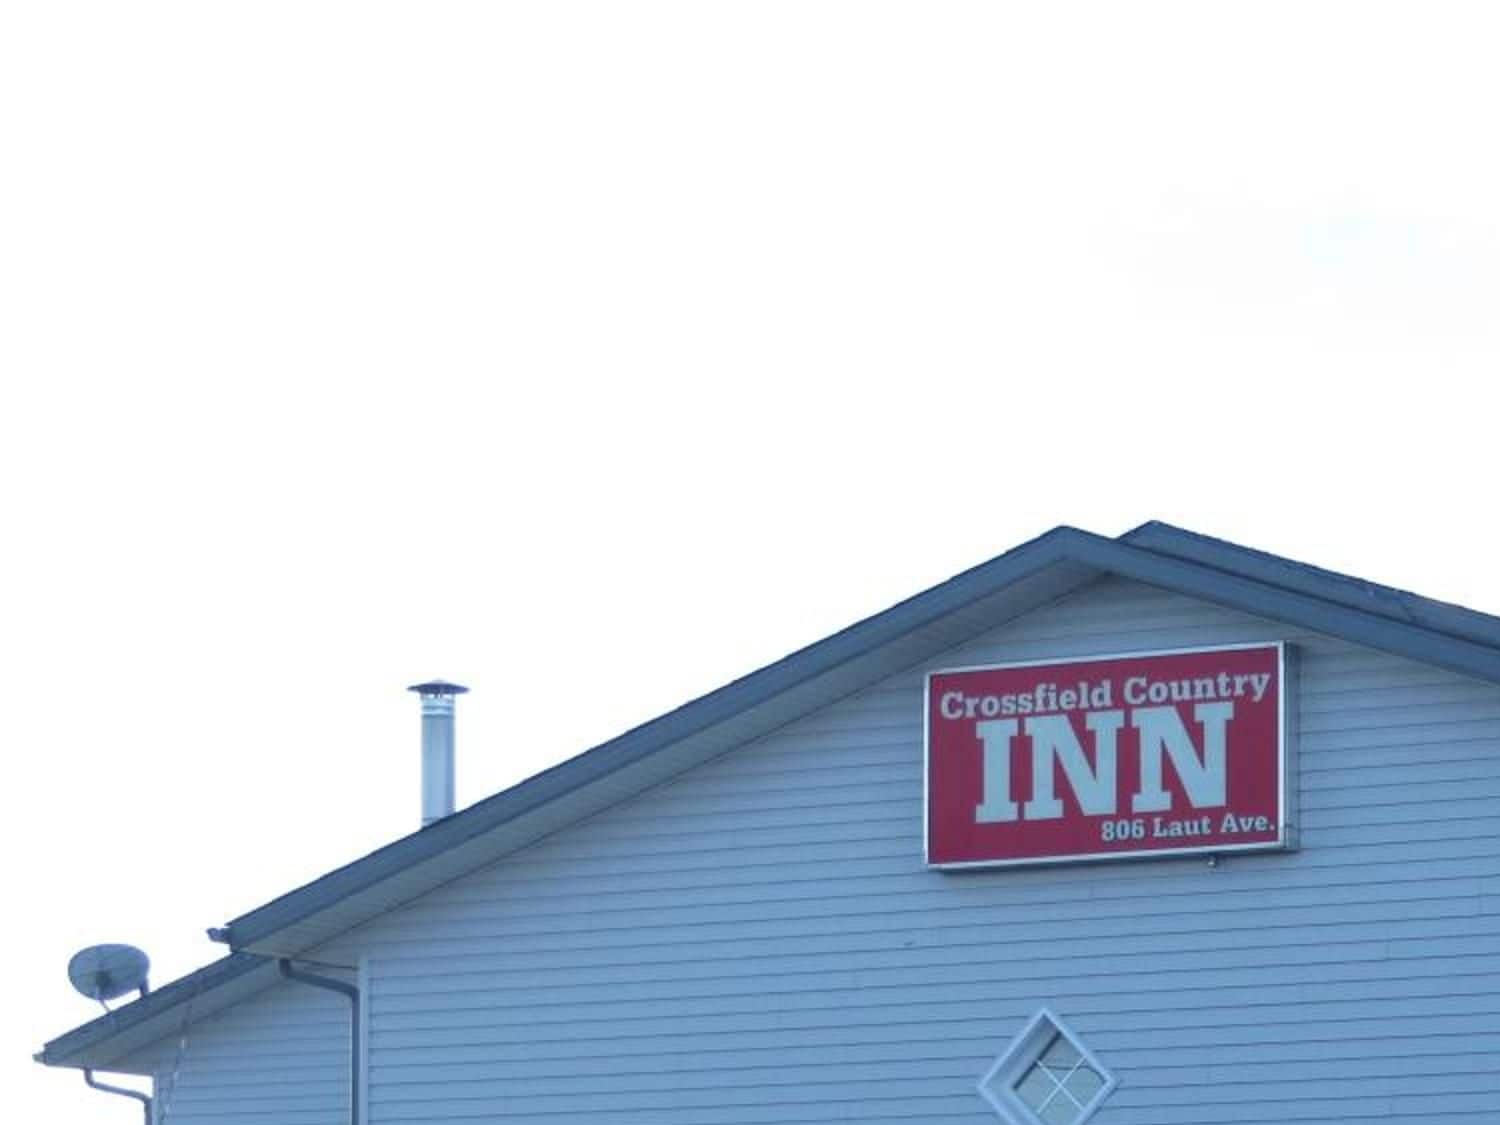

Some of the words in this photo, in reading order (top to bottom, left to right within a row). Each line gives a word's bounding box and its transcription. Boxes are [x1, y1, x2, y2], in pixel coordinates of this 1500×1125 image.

[940, 680, 1112, 719] Crossfield
[1123, 672, 1271, 703] Country
[975, 701, 1234, 824] INN
[1101, 818, 1145, 841] 806
[1153, 816, 1211, 838] Laut
[1219, 812, 1275, 833] Ave.
